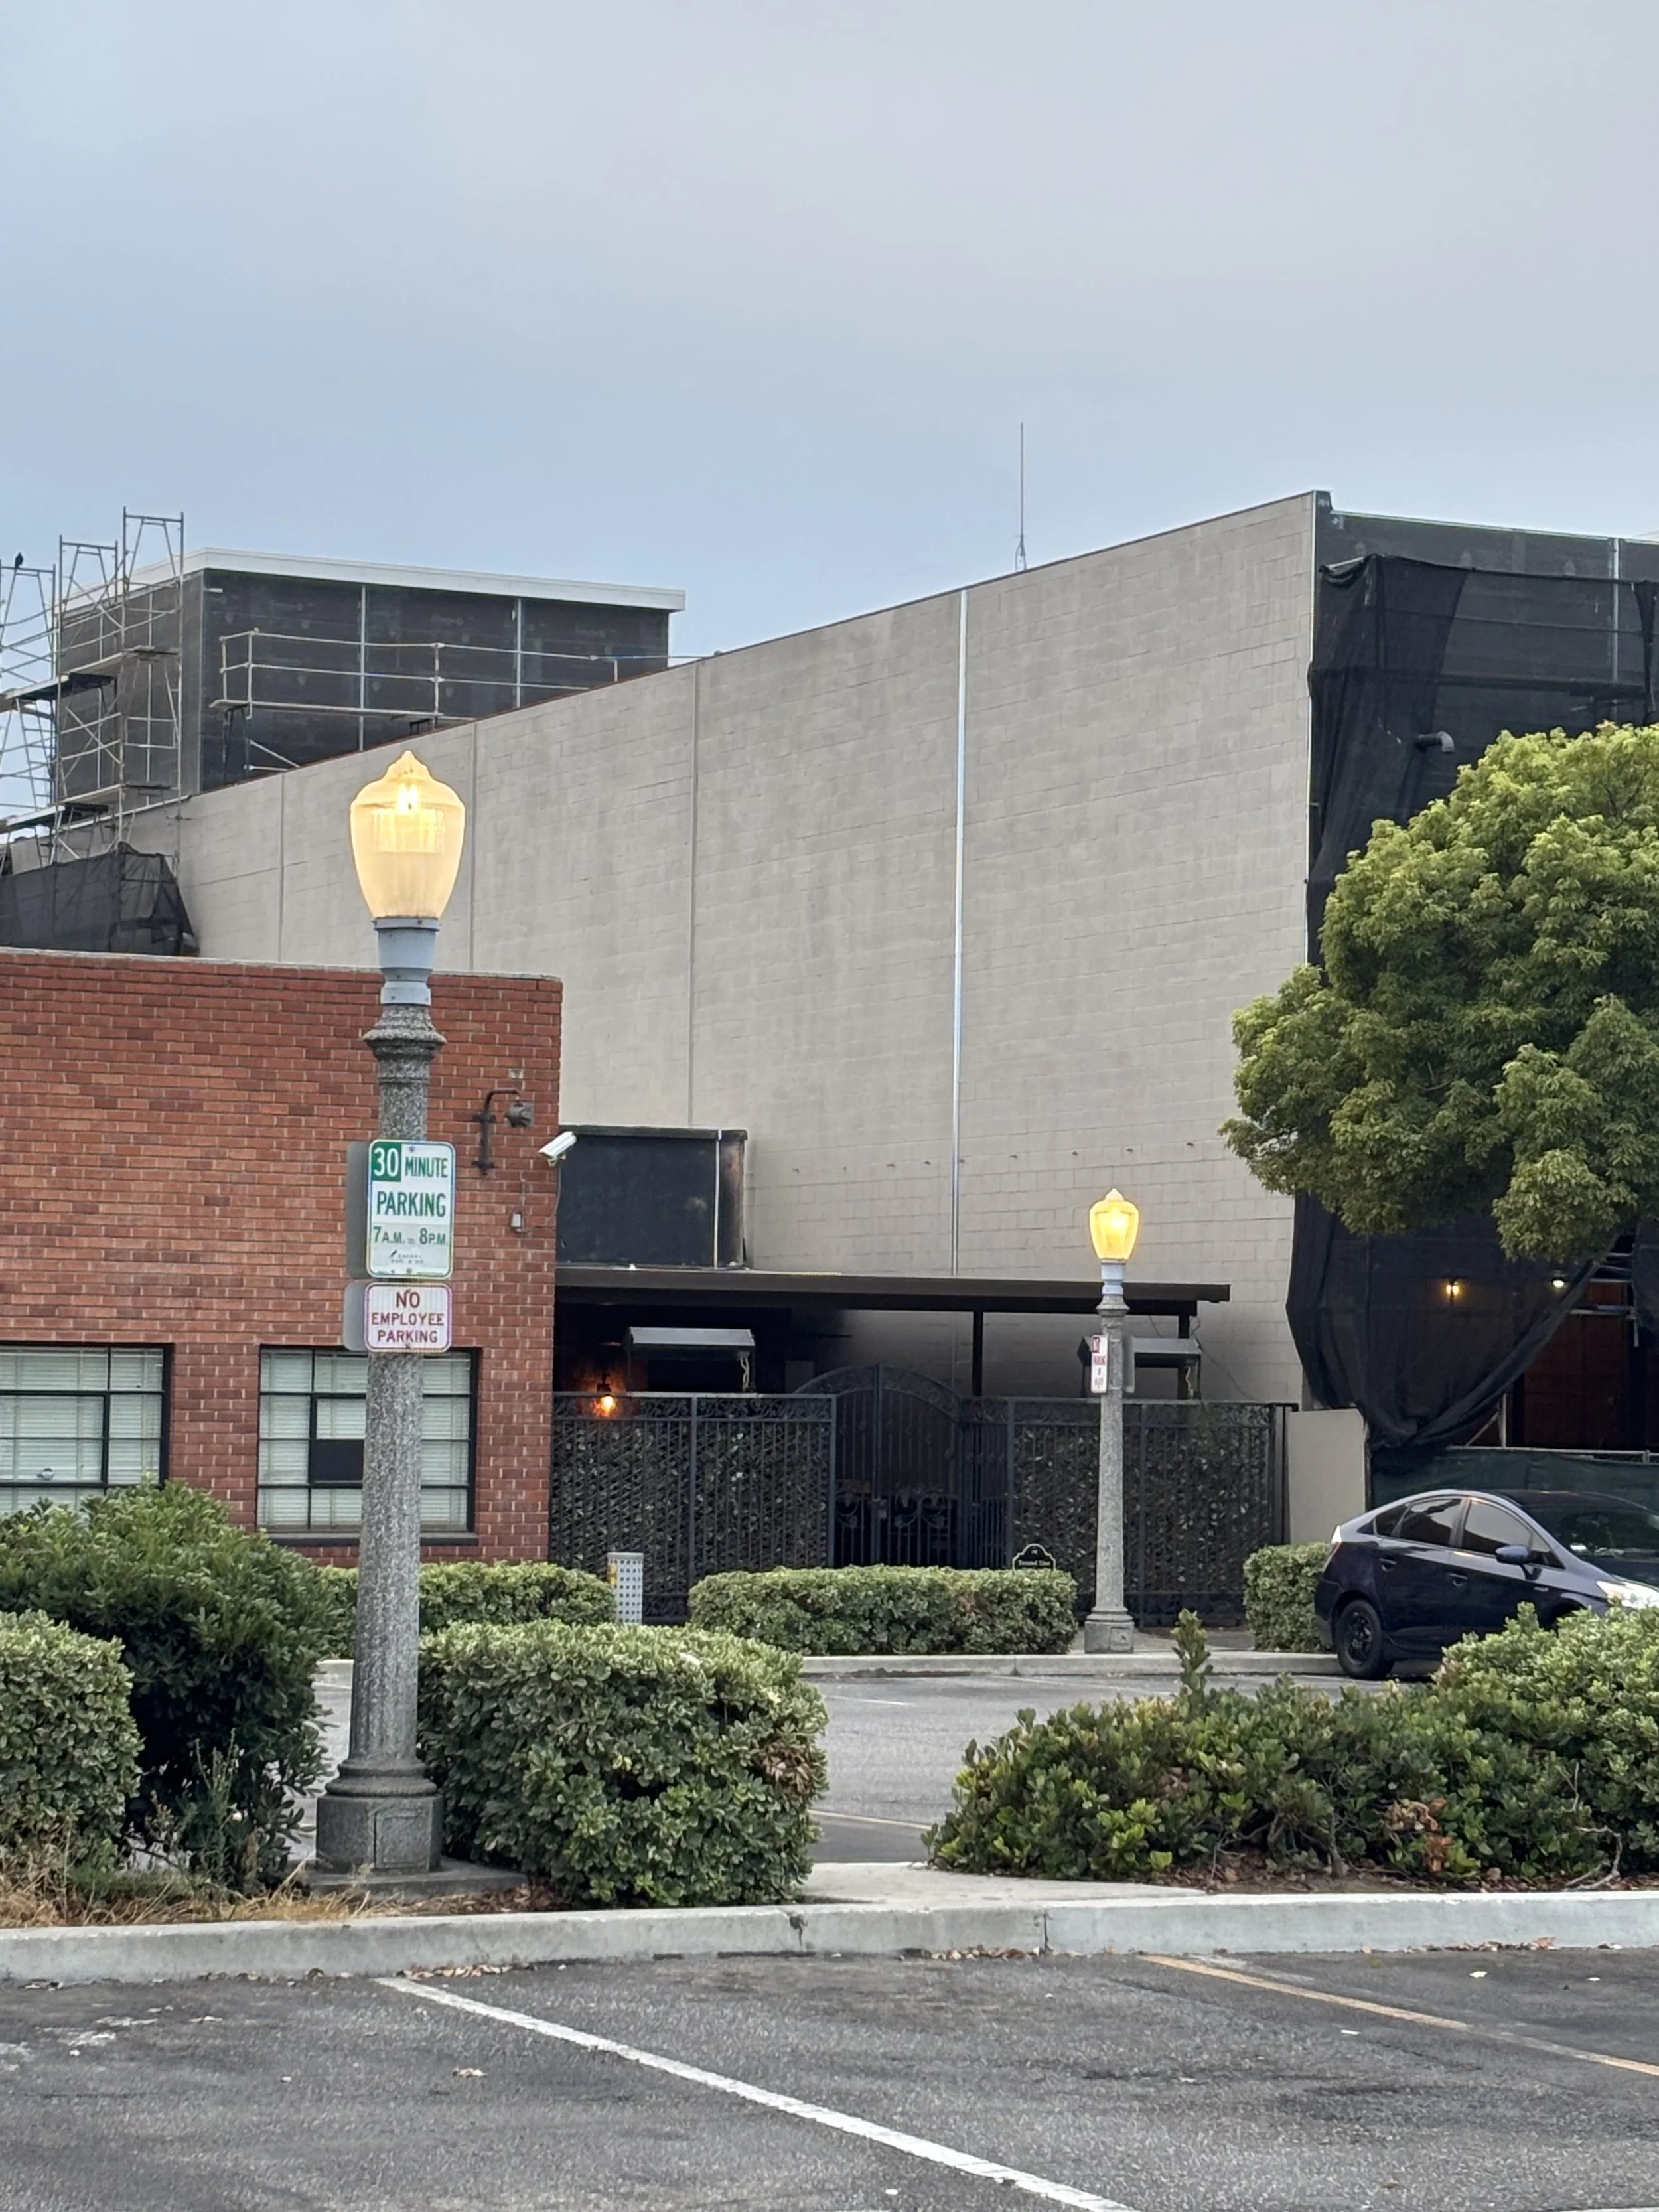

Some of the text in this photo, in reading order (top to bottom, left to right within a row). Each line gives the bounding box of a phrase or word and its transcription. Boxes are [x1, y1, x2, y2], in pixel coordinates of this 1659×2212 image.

[374, 1147, 448, 1177] 30 MINUTE
[377, 1191, 446, 1217] PARKING
[396, 1291, 420, 1308] NO
[372, 1313, 444, 1326] EMPLOYEE
[378, 1329, 438, 1343] PARKING
